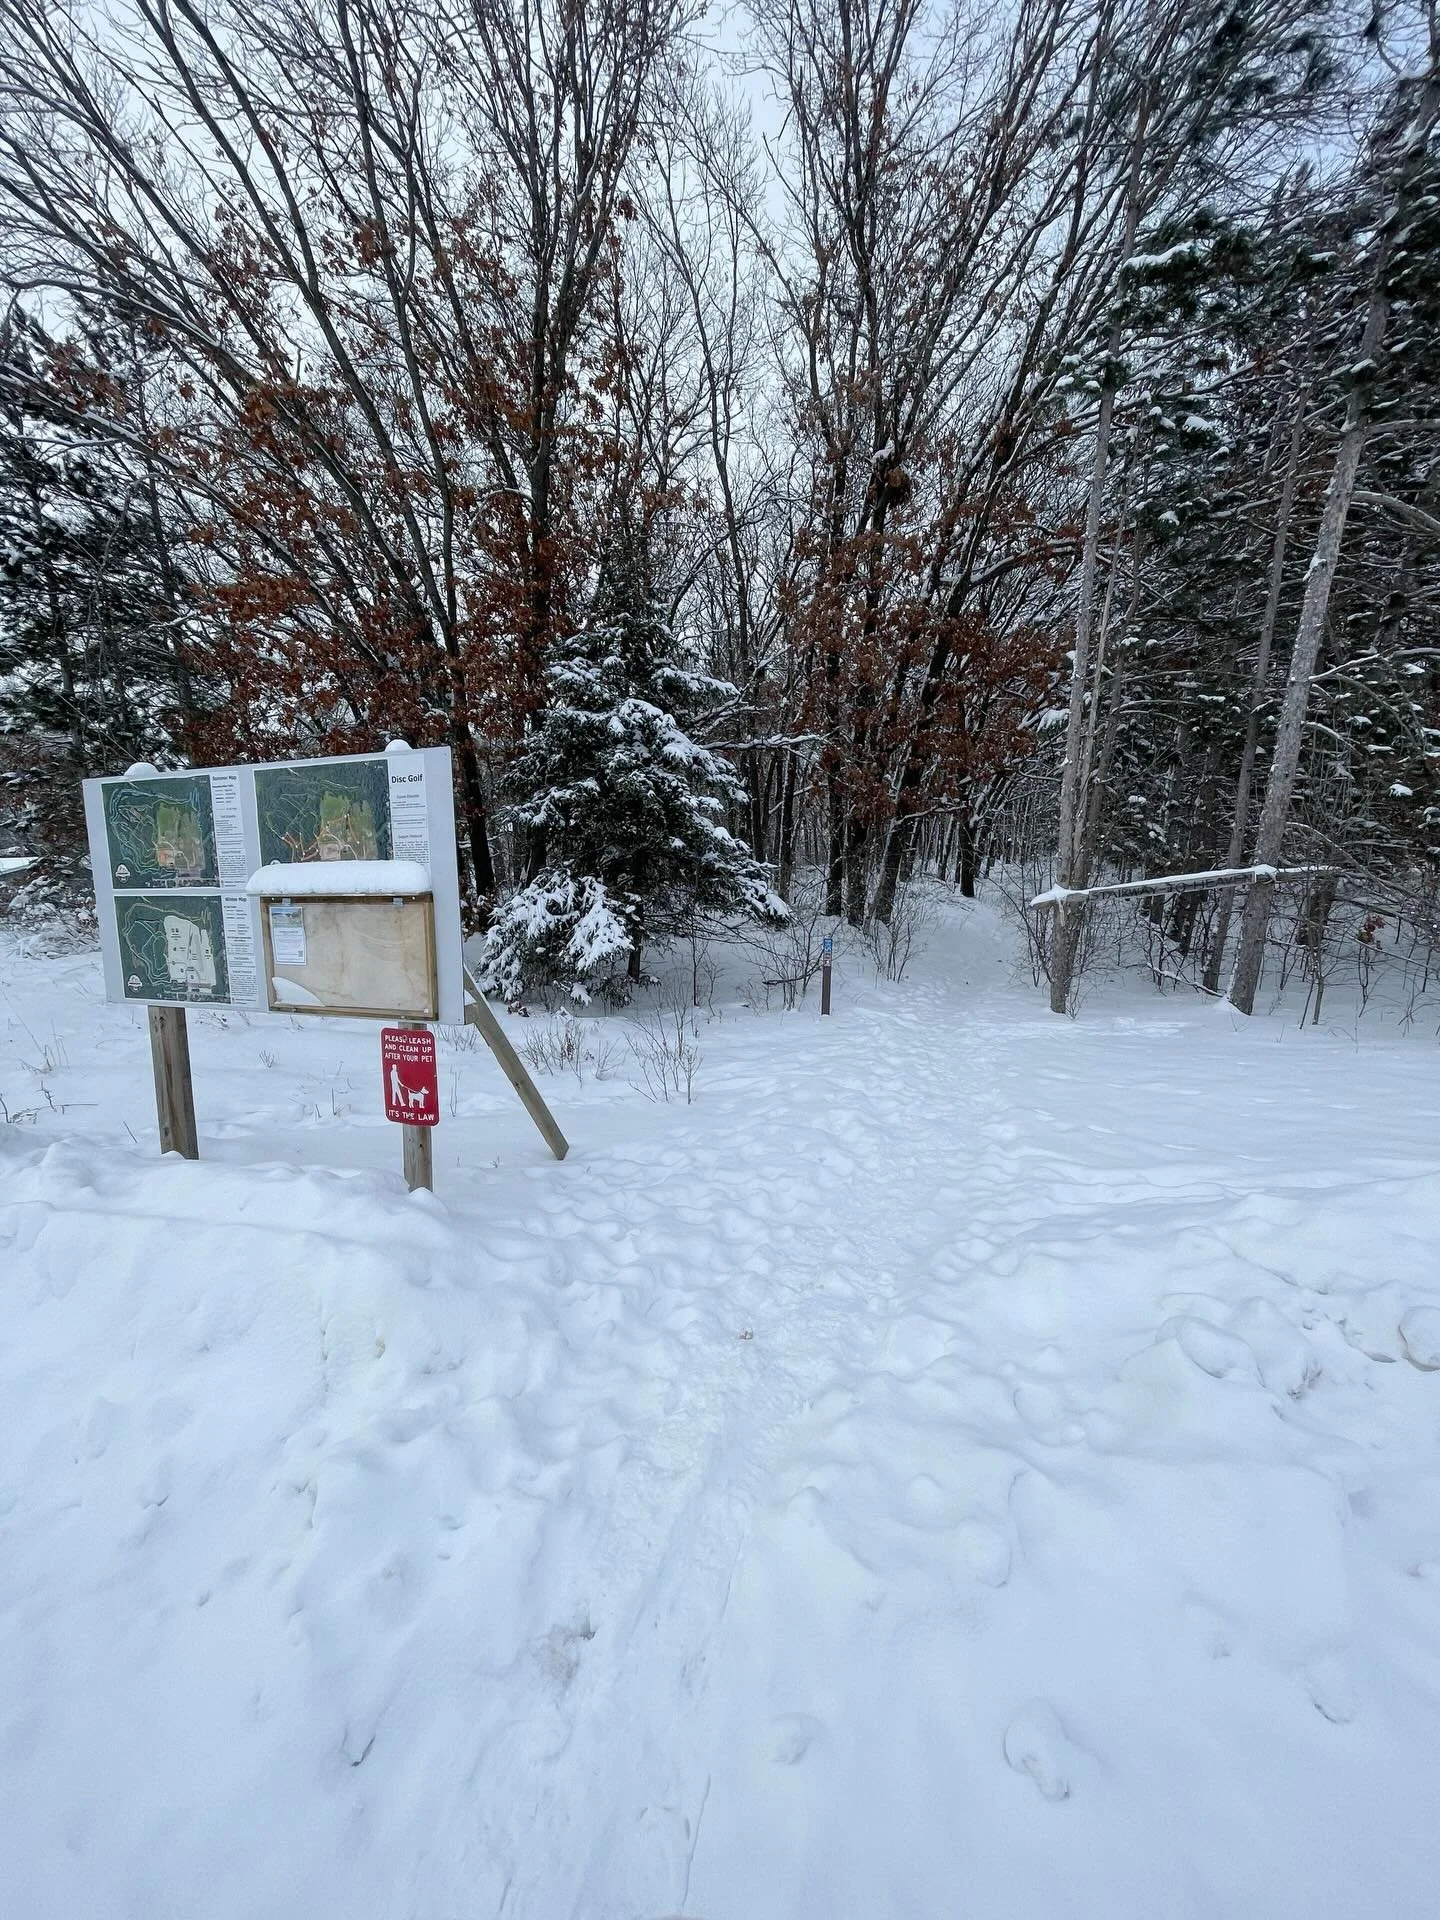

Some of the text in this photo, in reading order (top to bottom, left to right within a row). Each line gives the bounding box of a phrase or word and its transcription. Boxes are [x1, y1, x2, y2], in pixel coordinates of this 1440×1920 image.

[391, 774, 423, 783] Disc Golf
[1091, 873, 1253, 900] STAIRWAY TO HEAVEN
[409, 1037, 431, 1045] LEASH
[384, 1052, 400, 1060] AFTER
[403, 1054, 418, 1062] YOUR
[388, 1109, 434, 1121] IT'S THE LAW
